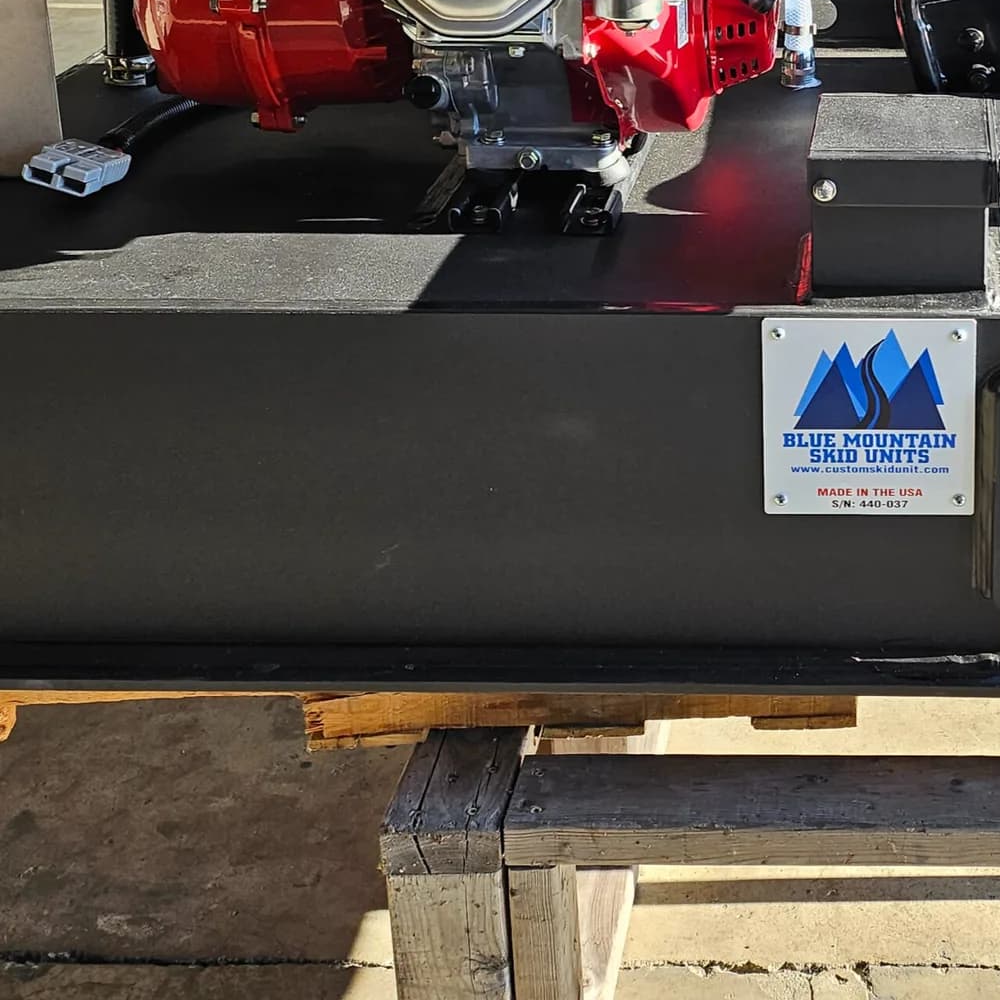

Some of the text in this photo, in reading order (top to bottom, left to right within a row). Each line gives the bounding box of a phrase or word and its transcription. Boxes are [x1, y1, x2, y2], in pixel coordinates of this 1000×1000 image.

[783, 433, 957, 448] BLUE MOUNTAIN
[810, 449, 930, 464] SKID UNITS
[791, 465, 949, 474] www.customskidunit.com
[817, 488, 923, 497] MADE IN THE USA
[832, 500, 909, 509] S/N: 440-037
